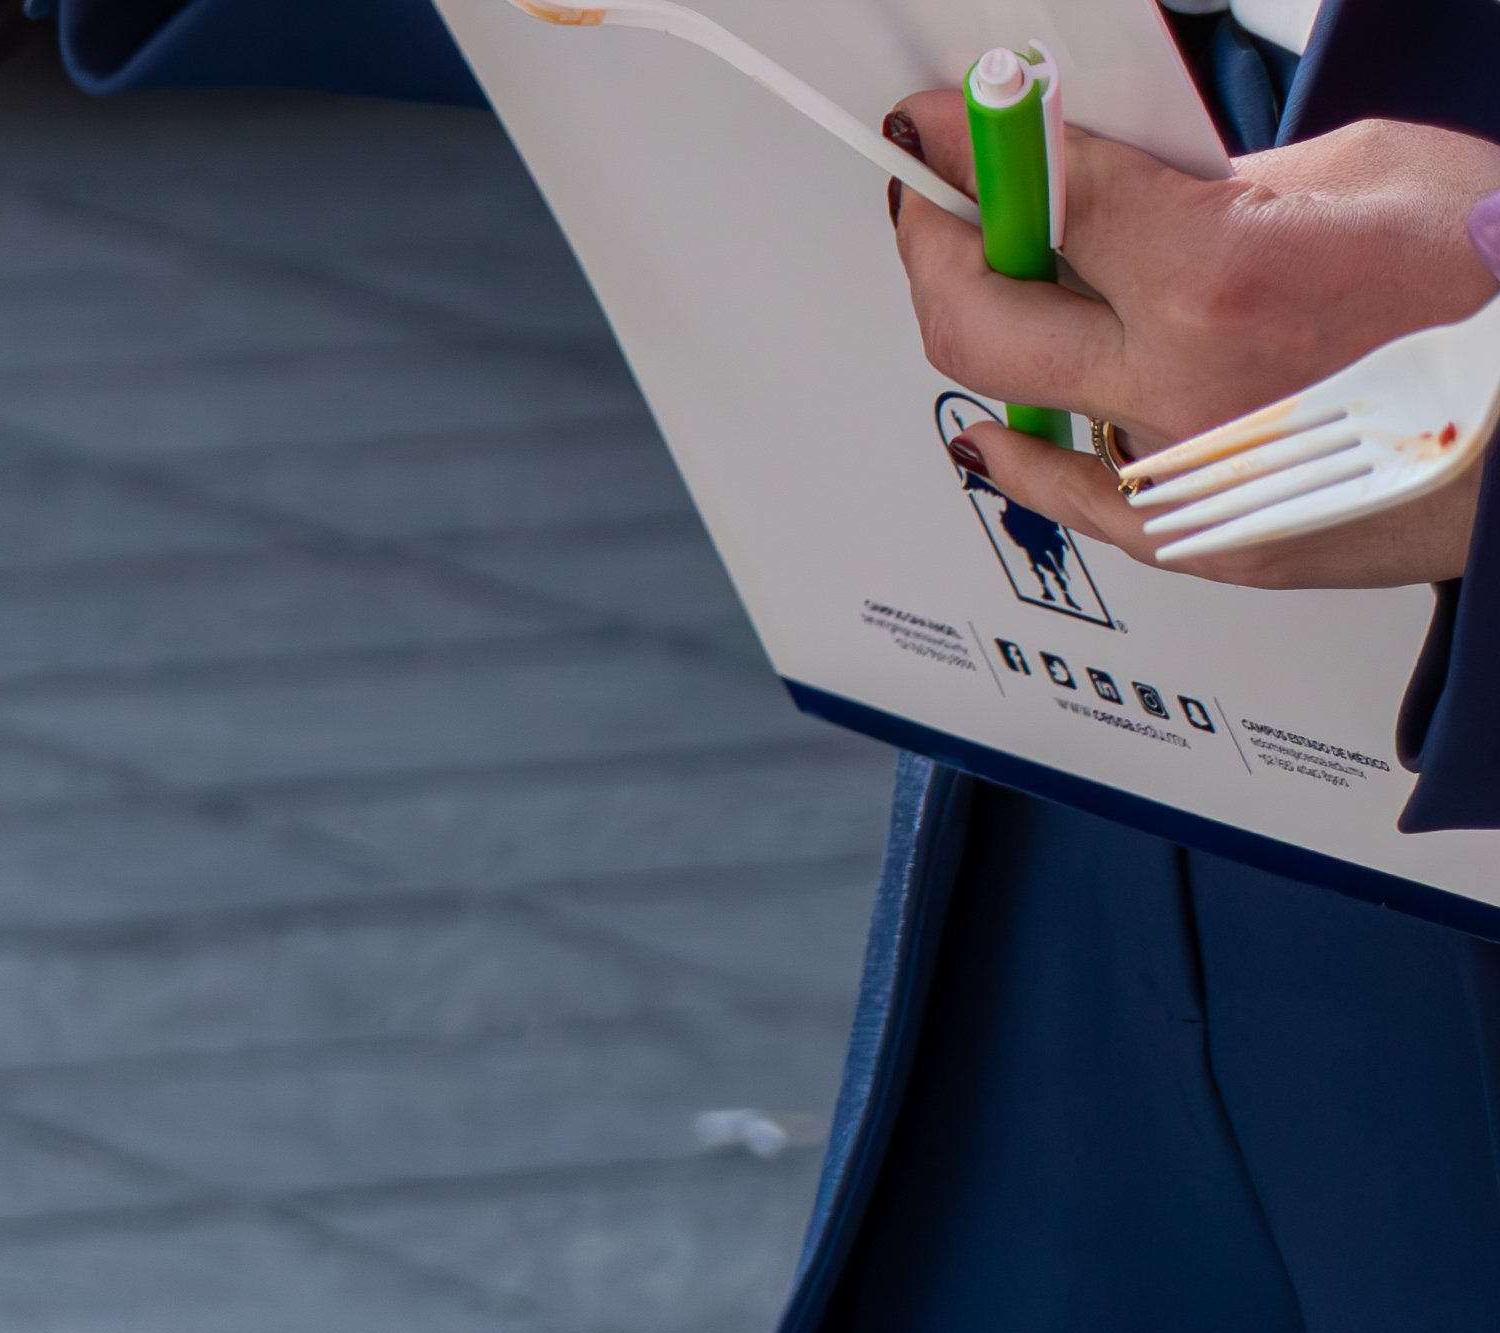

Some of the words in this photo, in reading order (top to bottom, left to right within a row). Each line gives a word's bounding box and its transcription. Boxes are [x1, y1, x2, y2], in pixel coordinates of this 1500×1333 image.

[1241, 718, 1287, 741] CAMPUS
[1287, 732, 1330, 754] ESTADO
[1330, 745, 1347, 759] DE
[1347, 750, 1391, 772] MÉXICO
